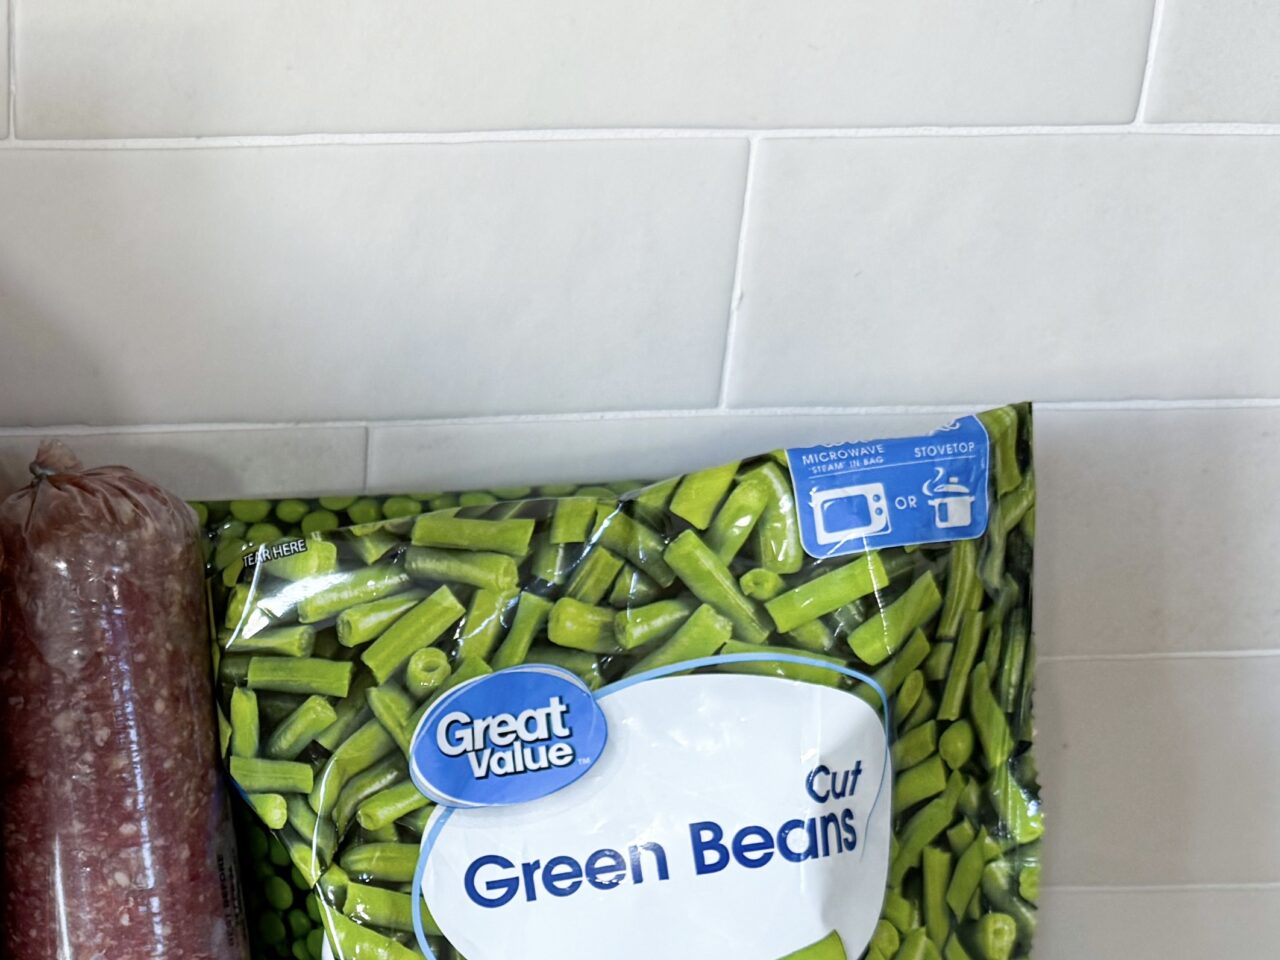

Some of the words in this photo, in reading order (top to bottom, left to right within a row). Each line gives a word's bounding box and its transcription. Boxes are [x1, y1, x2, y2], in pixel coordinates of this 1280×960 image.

[802, 444, 885, 465] MICROWAVE
[914, 442, 975, 458] STOVETOP
[895, 496, 918, 510] OR
[243, 550, 271, 567] TEAR
[273, 539, 306, 558] HERE
[437, 696, 571, 757] Great
[467, 741, 574, 779] Value
[806, 760, 862, 804] Cut
[464, 840, 670, 909] Green
[689, 807, 857, 875] Beans
